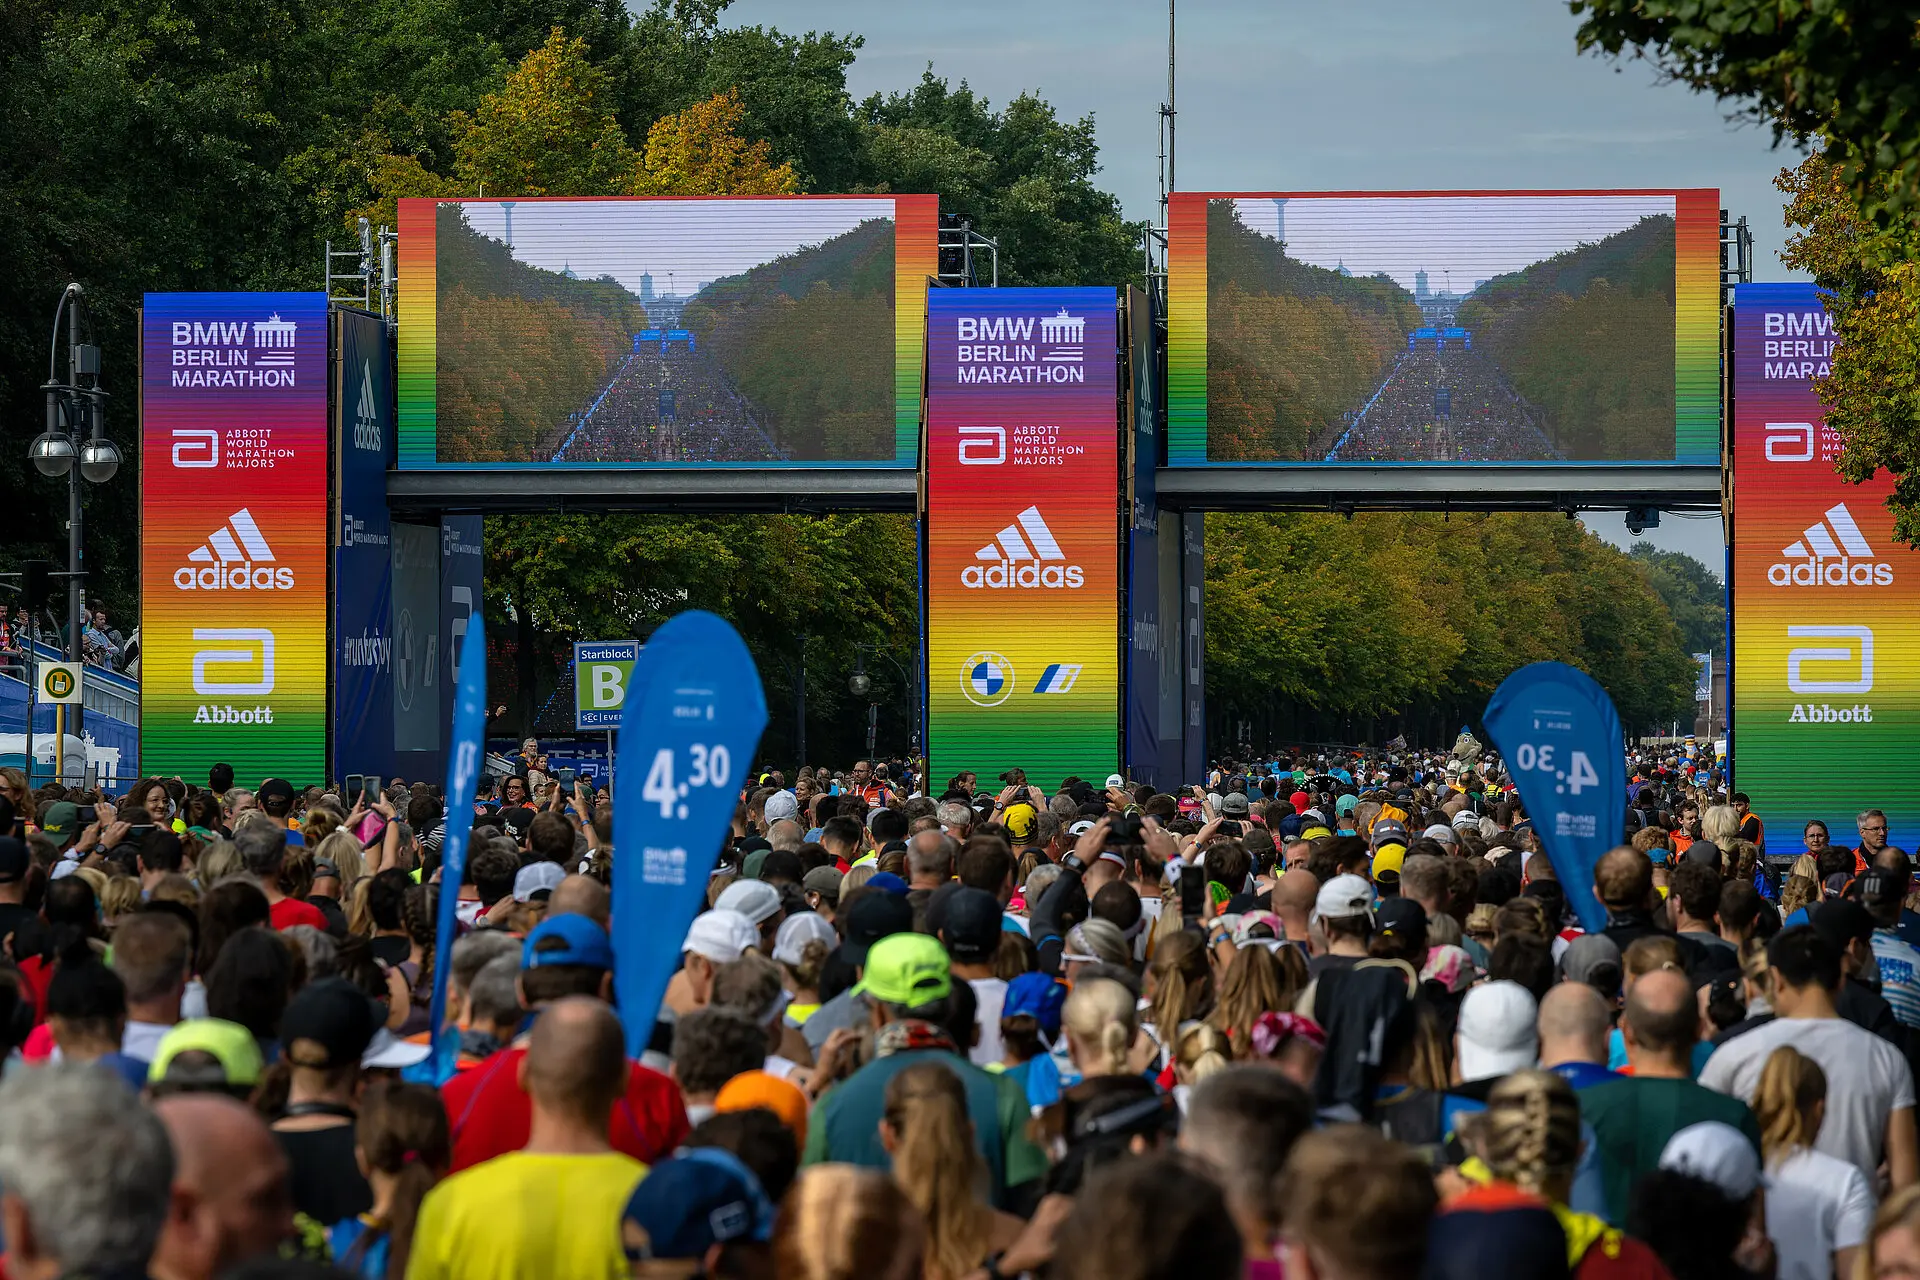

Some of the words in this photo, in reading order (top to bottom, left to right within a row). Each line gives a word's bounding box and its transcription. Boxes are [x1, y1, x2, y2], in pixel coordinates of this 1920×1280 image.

[172, 322, 248, 346] BMW
[957, 317, 1035, 341] BMW
[172, 349, 248, 366] BERLIN
[957, 345, 1036, 362] BERLIN
[172, 369, 295, 387] MARATHON
[957, 365, 1084, 383] MARATHON
[1764, 361, 1833, 379] MARA
[226, 429, 272, 439] ABBOTT
[353, 416, 381, 452] adidas
[1013, 426, 1060, 435] ABBOTT
[226, 439, 268, 448] WORLD
[1013, 435, 1057, 445] WORLD
[226, 449, 295, 458] MARATHON
[1013, 446, 1084, 454] MARATHON
[226, 459, 275, 468] MAJORS
[1013, 456, 1063, 465] MAJORS
[173, 561, 295, 590] adidas
[960, 558, 1085, 589] adidas
[1767, 556, 1894, 586] adidas
[581, 649, 632, 660] Startblock
[592, 665, 625, 708] B
[193, 705, 274, 724] Abbott
[1788, 704, 1873, 723] Abbott
